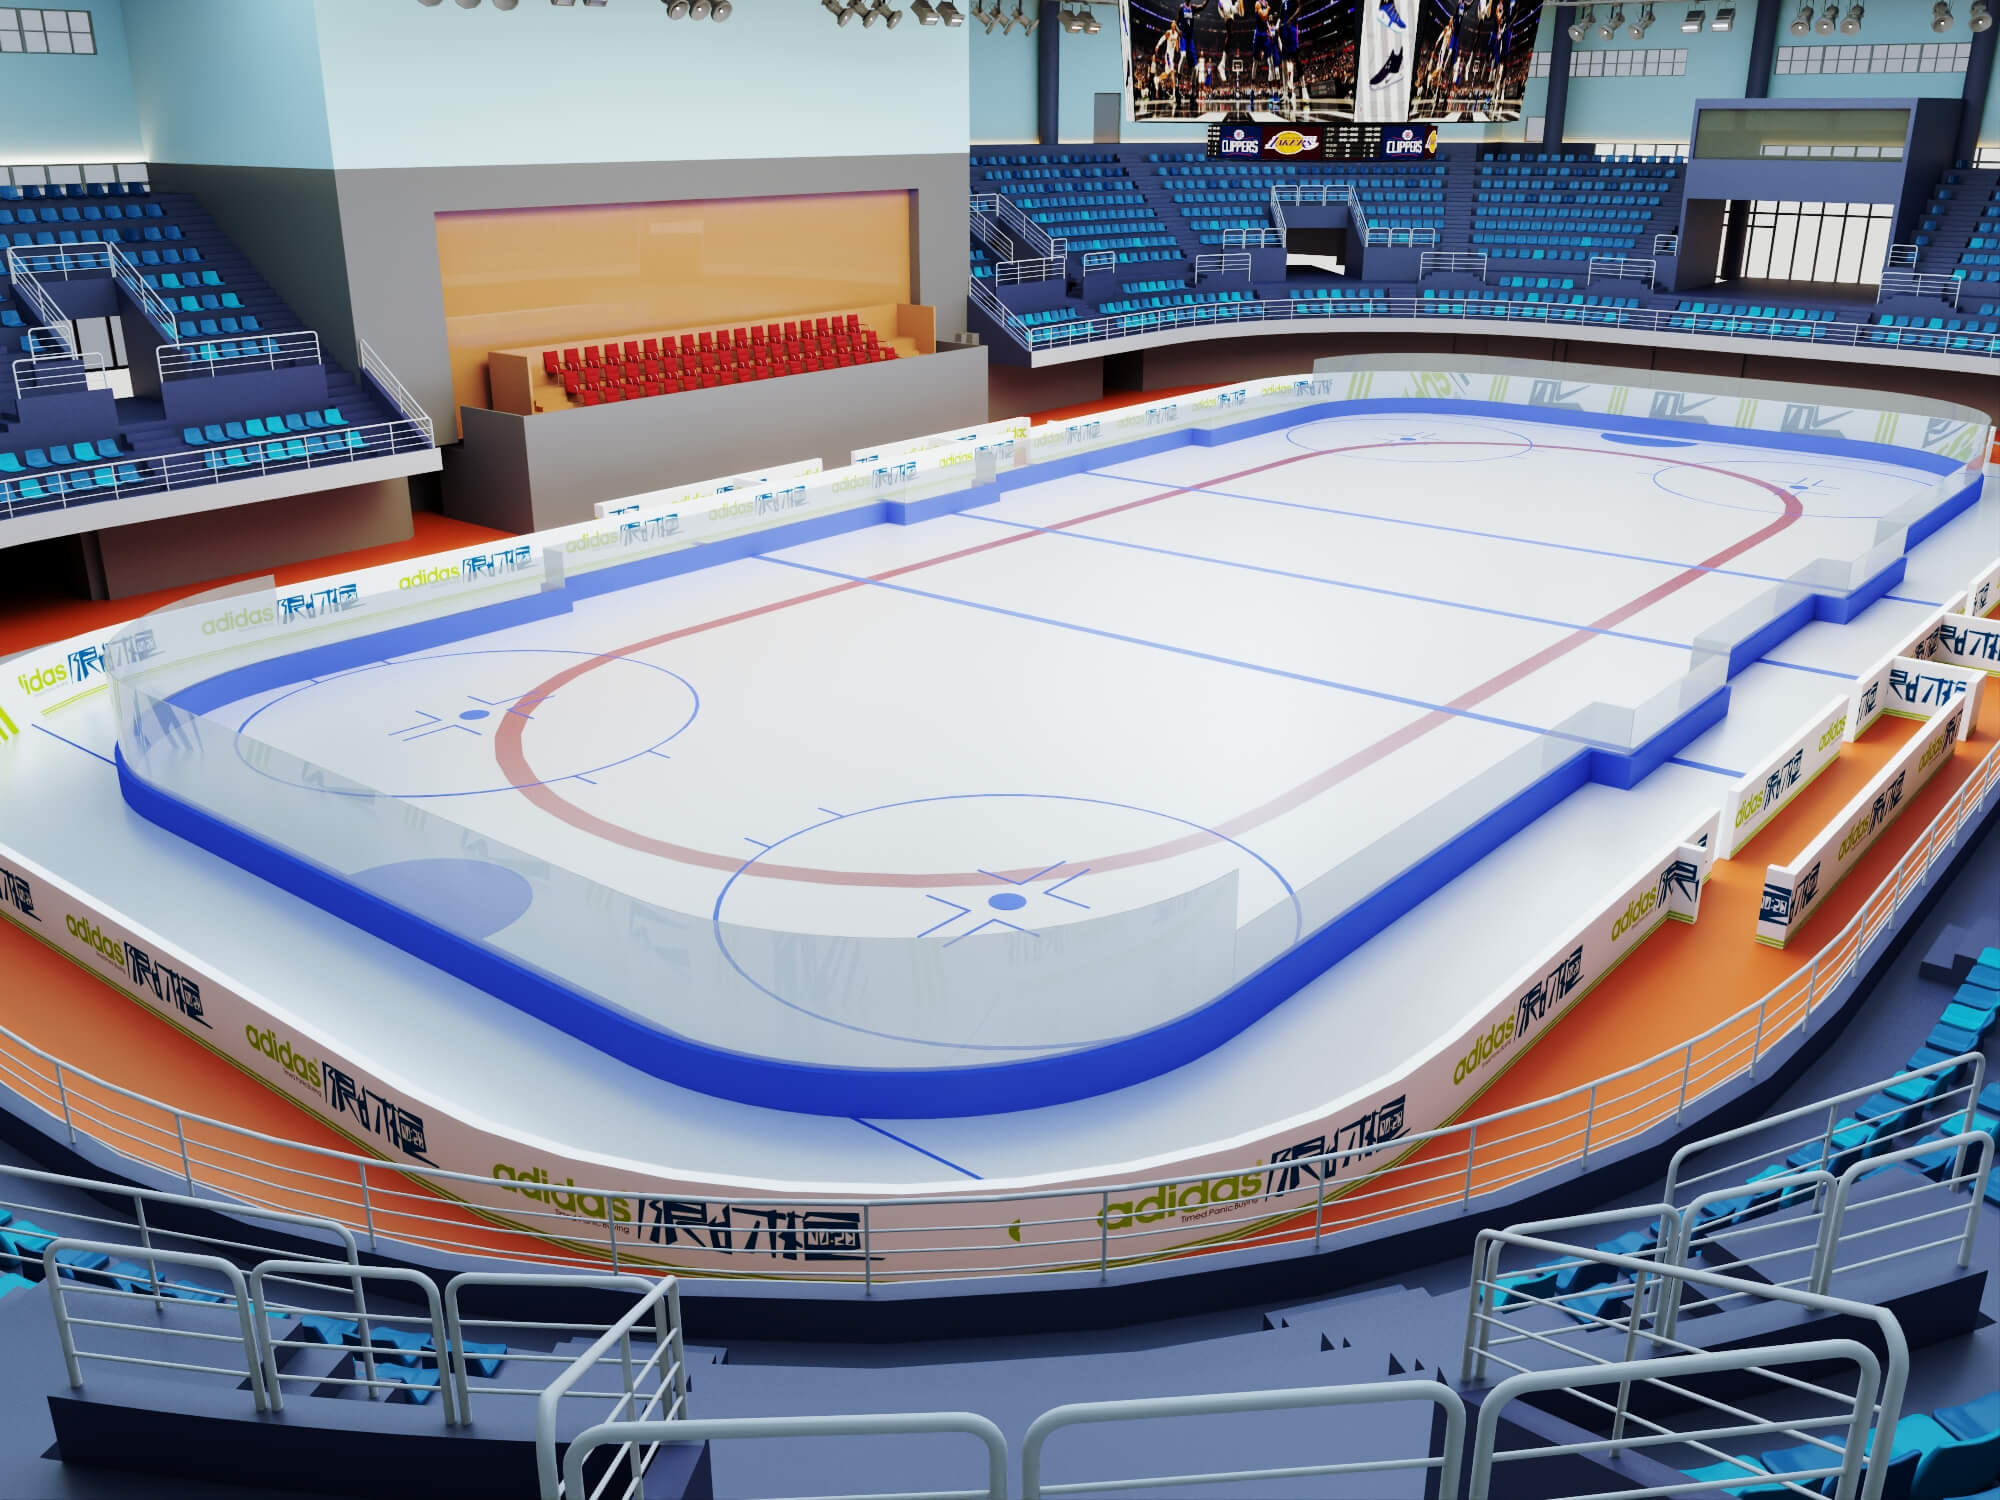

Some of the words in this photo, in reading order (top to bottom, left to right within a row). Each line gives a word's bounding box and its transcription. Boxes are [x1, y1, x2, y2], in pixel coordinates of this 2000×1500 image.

[1222, 139, 1259, 153] CLIPPERS
[1385, 140, 1423, 153] CLIPPERS
[708, 501, 753, 520] adidas
[566, 528, 618, 553] adidas
[398, 565, 460, 590] adidas
[201, 606, 274, 636] adidas
[1838, 813, 1870, 861] adidas
[1611, 886, 1657, 942] adidas
[66, 914, 125, 966] adidas
[246, 1024, 321, 1088] adidas
[1453, 1013, 1515, 1085] adidas
[493, 1163, 632, 1222] adidas
[1097, 1174, 1263, 1230] adidas
[1181, 1209, 1208, 1223] Timed
[1209, 1204, 1234, 1216] Panic
